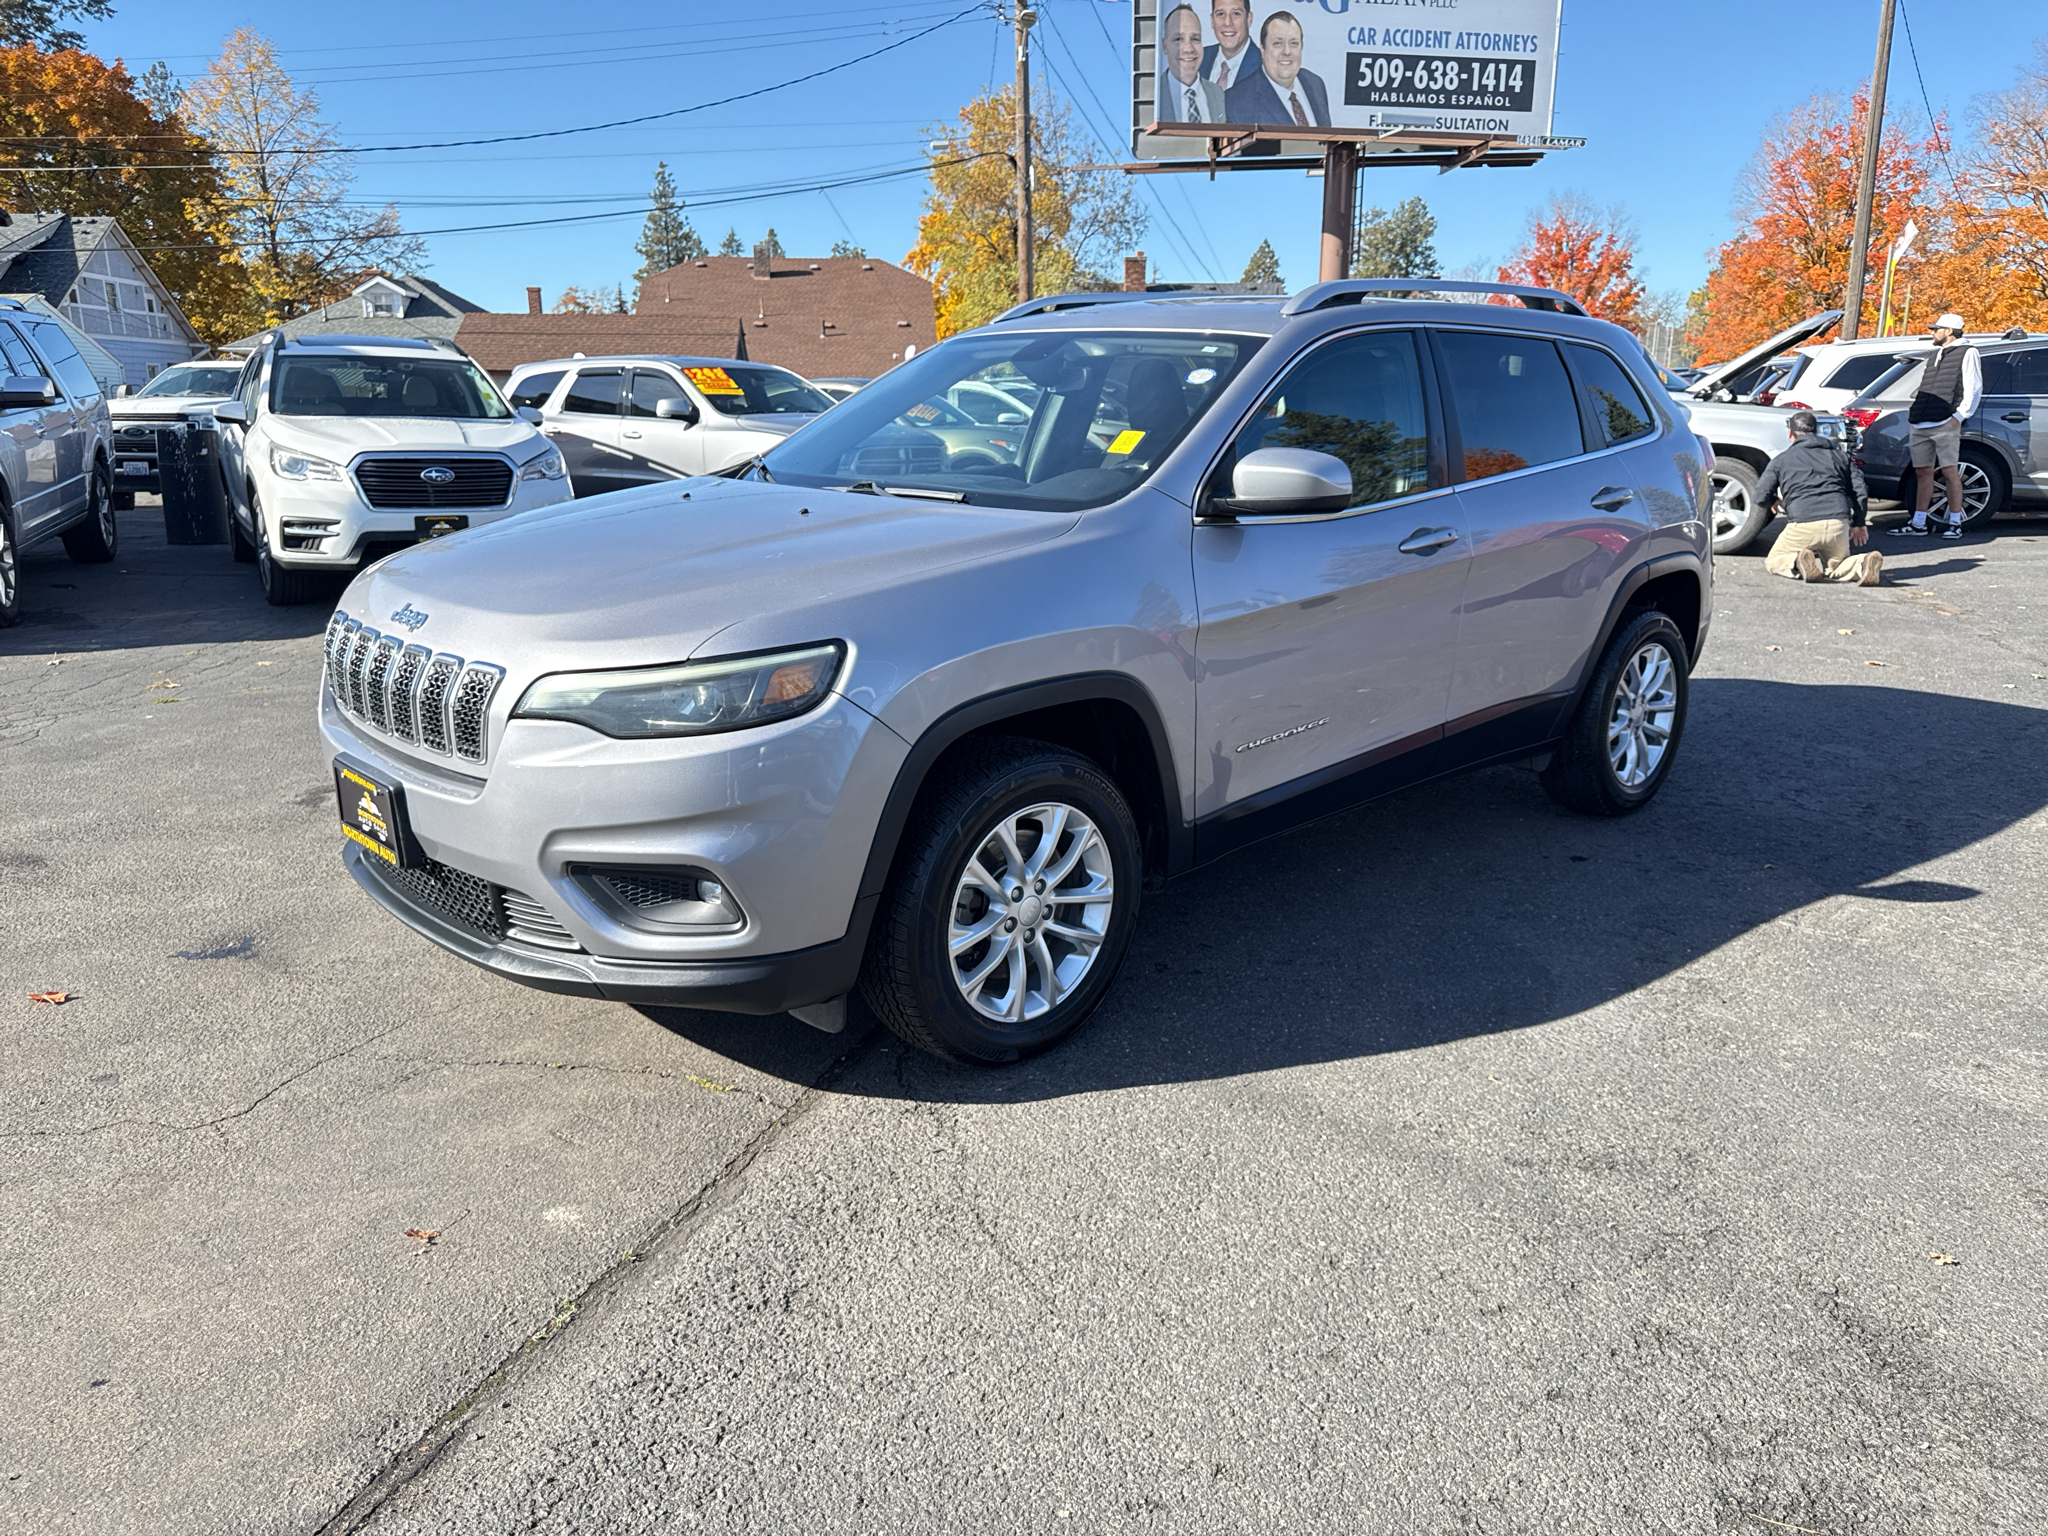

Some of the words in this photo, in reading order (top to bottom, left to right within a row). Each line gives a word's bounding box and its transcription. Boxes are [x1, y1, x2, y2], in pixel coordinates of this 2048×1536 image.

[1347, 26, 1377, 46] CAR
[1382, 28, 1452, 49] ACCIDENT
[1455, 31, 1538, 53] ATTORNEYS
[1357, 57, 1524, 93] 509-638-1414
[1370, 91, 1446, 105] HABLAMOS
[1451, 93, 1511, 107] ESPAÑOL
[1403, 116, 1510, 132] SULTATION
[1546, 138, 1583, 148] LAMAR
[391, 603, 430, 633] Jeep
[1235, 716, 1330, 754] CHEROKEE
[341, 823, 380, 855] NORTHTOWN
[379, 845, 397, 865] AUTO
